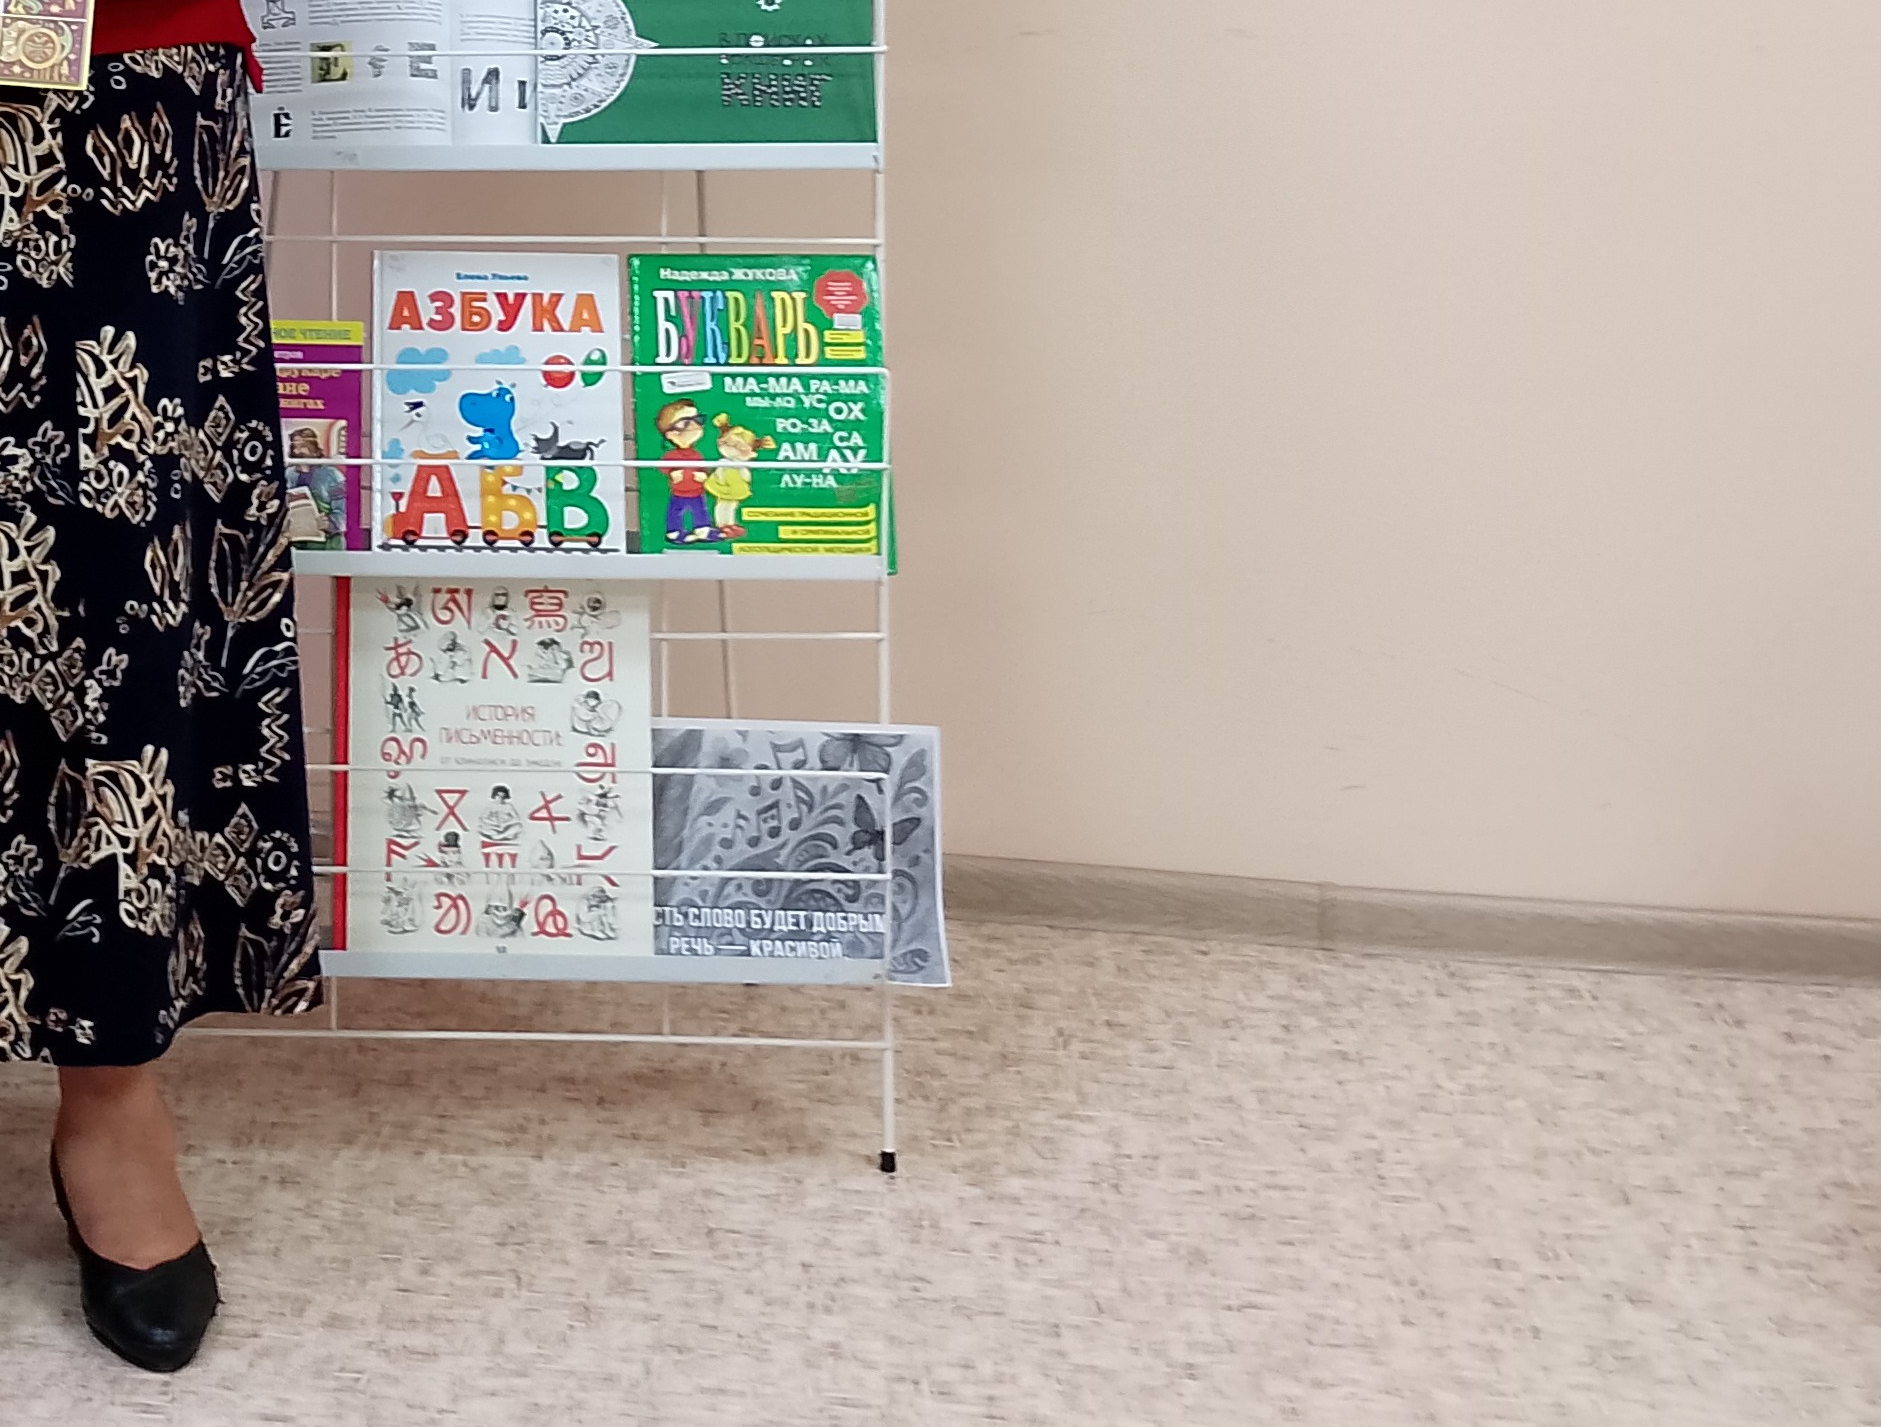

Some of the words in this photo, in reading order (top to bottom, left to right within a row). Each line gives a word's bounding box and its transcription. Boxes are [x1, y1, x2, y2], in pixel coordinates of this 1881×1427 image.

[720, 73, 833, 108] КНИГ
[659, 268, 729, 281] Надежда
[731, 268, 800, 281] ЖУКОВА
[388, 290, 604, 333] АЗБУКА
[652, 290, 819, 365] БУКВАРЬ
[723, 376, 805, 393] МА-МА
[809, 379, 869, 393] РА-МА
[800, 394, 828, 408] УС
[828, 401, 867, 420] ОХ
[775, 418, 834, 433] РО-ЗА
[832, 431, 864, 447] СА
[777, 442, 819, 460] АМ
[779, 473, 837, 488] ЛУ-НА
[404, 463, 470, 539] А
[482, 464, 538, 539] Б
[546, 465, 610, 539] В
[465, 704, 536, 722] ИСТОРИЯ
[688, 907, 747, 929] СЛОВО
[749, 909, 808, 932] БУДЕТ
[669, 937, 715, 956] РЕЧЬ
[748, 936, 844, 959] КРАСИВОЙ
